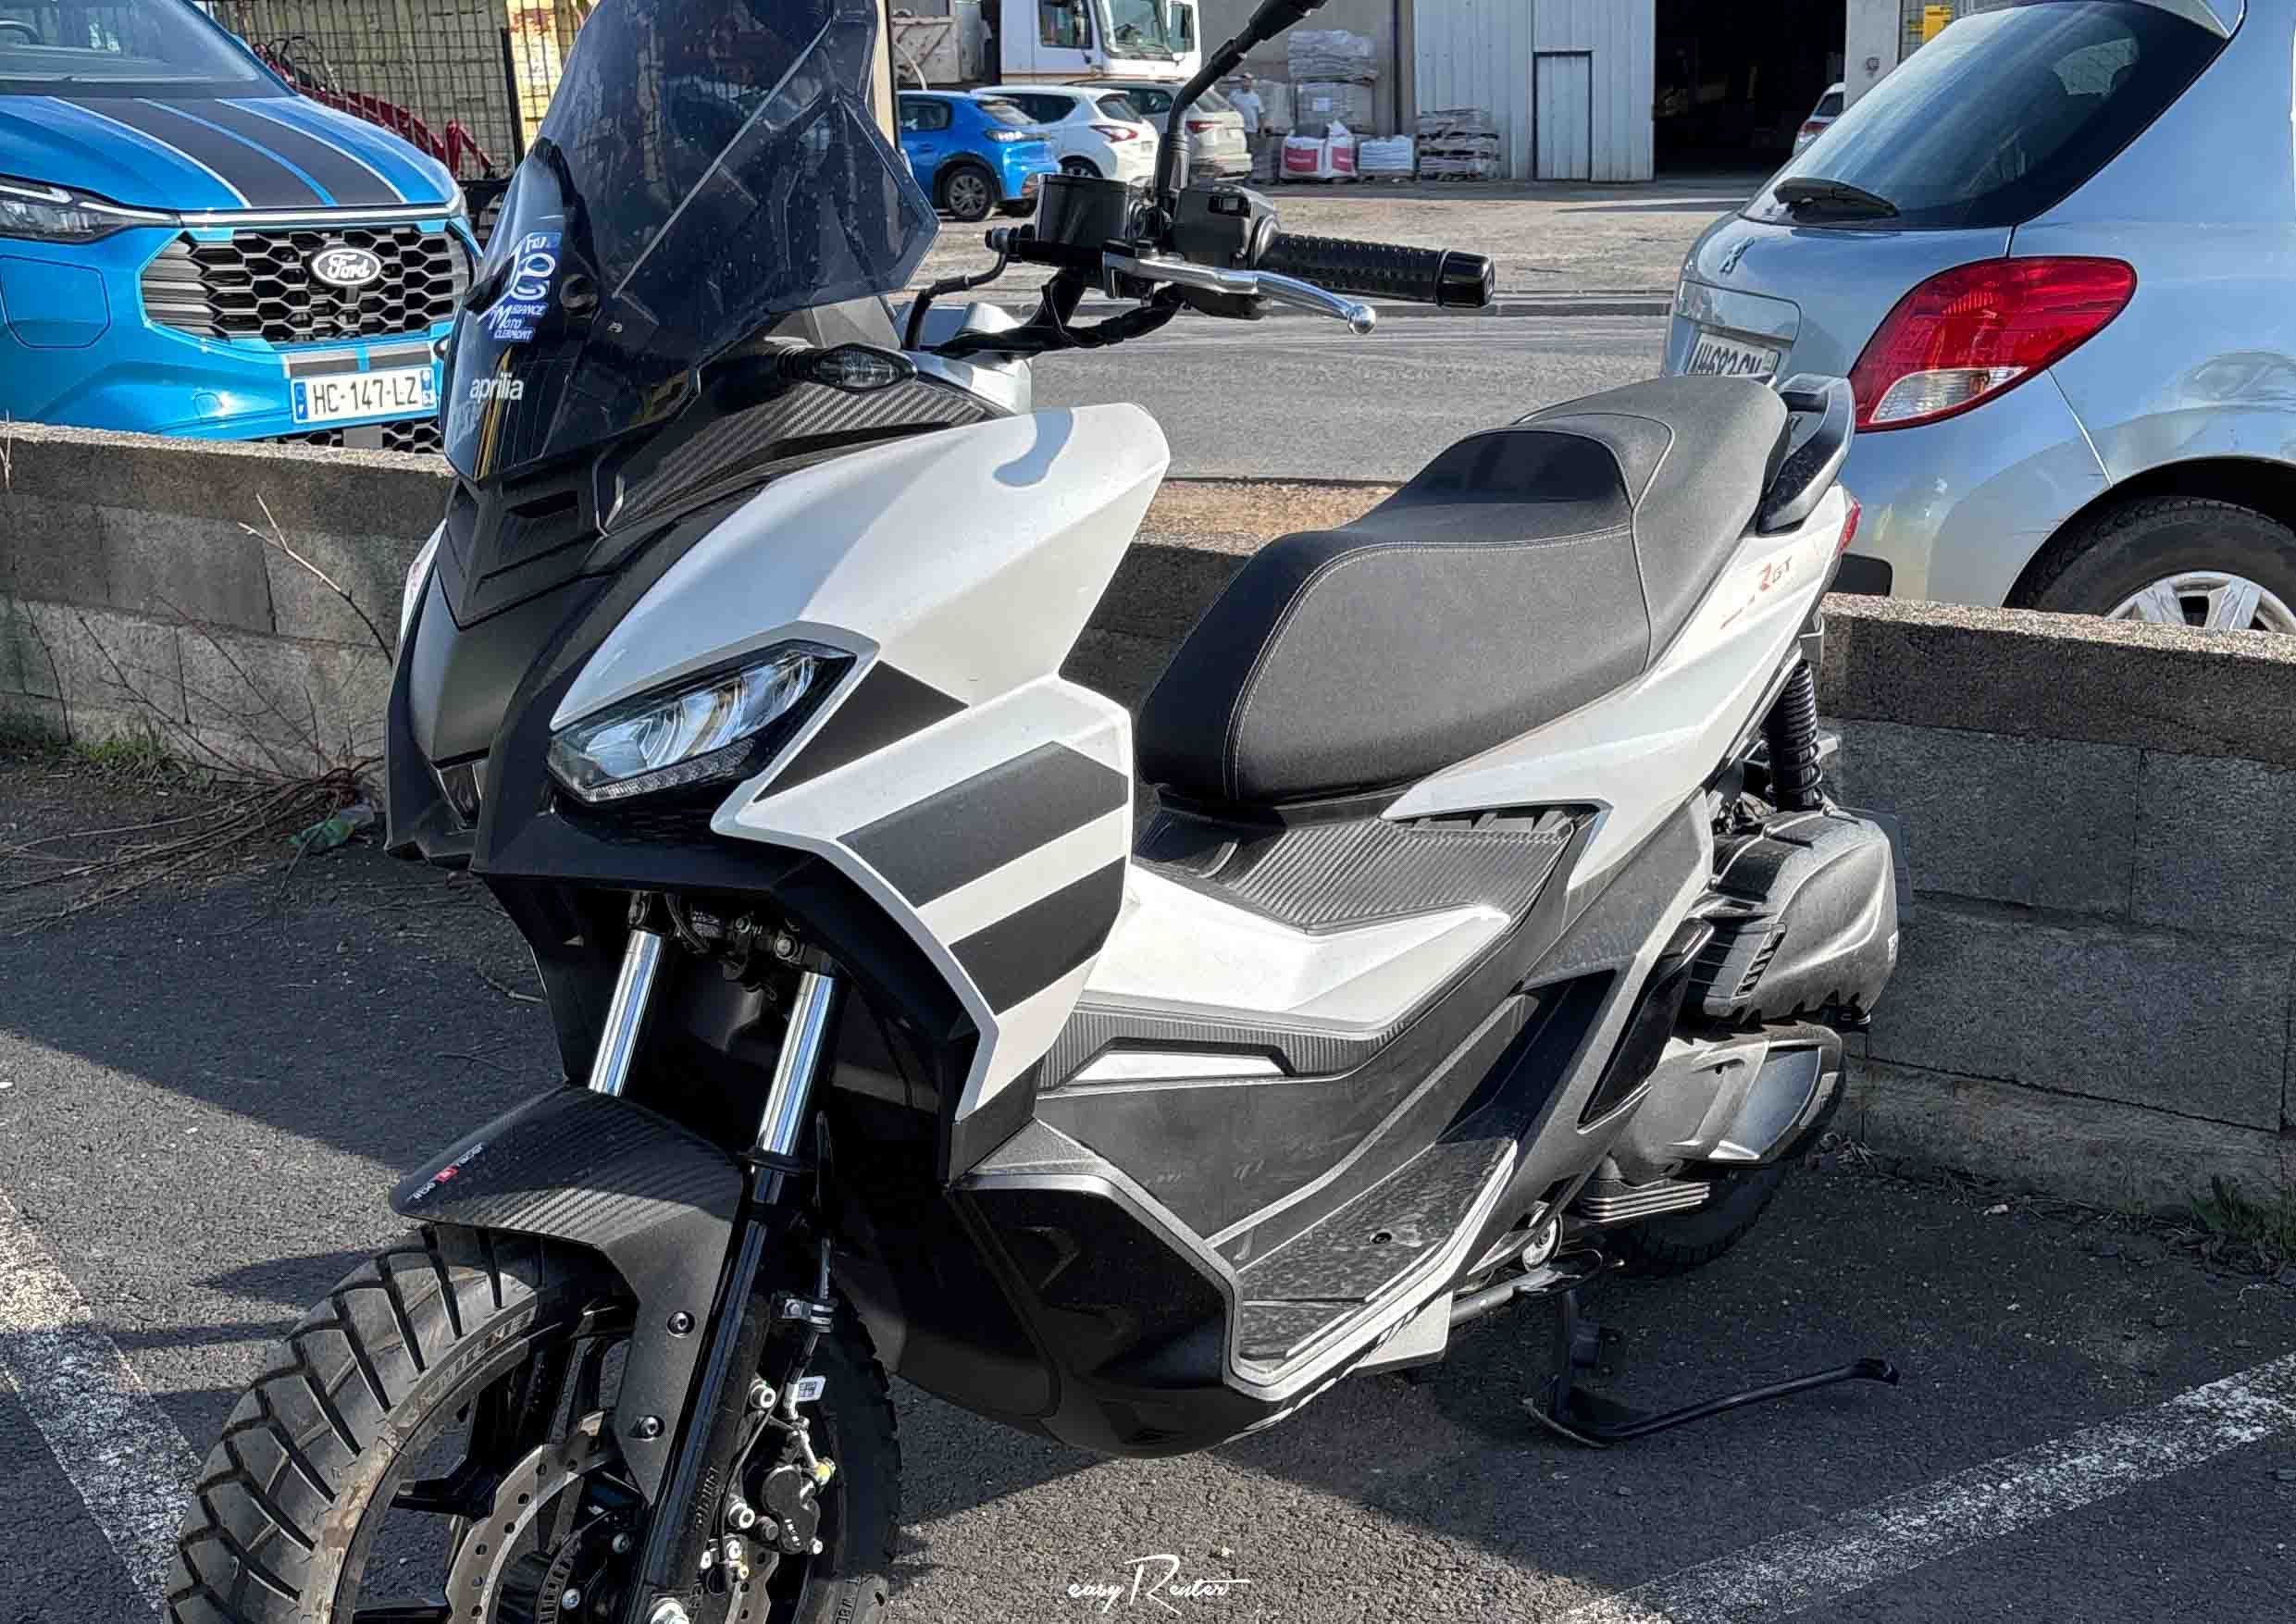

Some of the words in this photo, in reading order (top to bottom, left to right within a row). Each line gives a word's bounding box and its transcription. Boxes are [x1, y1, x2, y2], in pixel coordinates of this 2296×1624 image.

[327, 254, 370, 279] Ford
[313, 376, 418, 415] HC-147-LZ
[470, 372, 525, 403] aprilia
